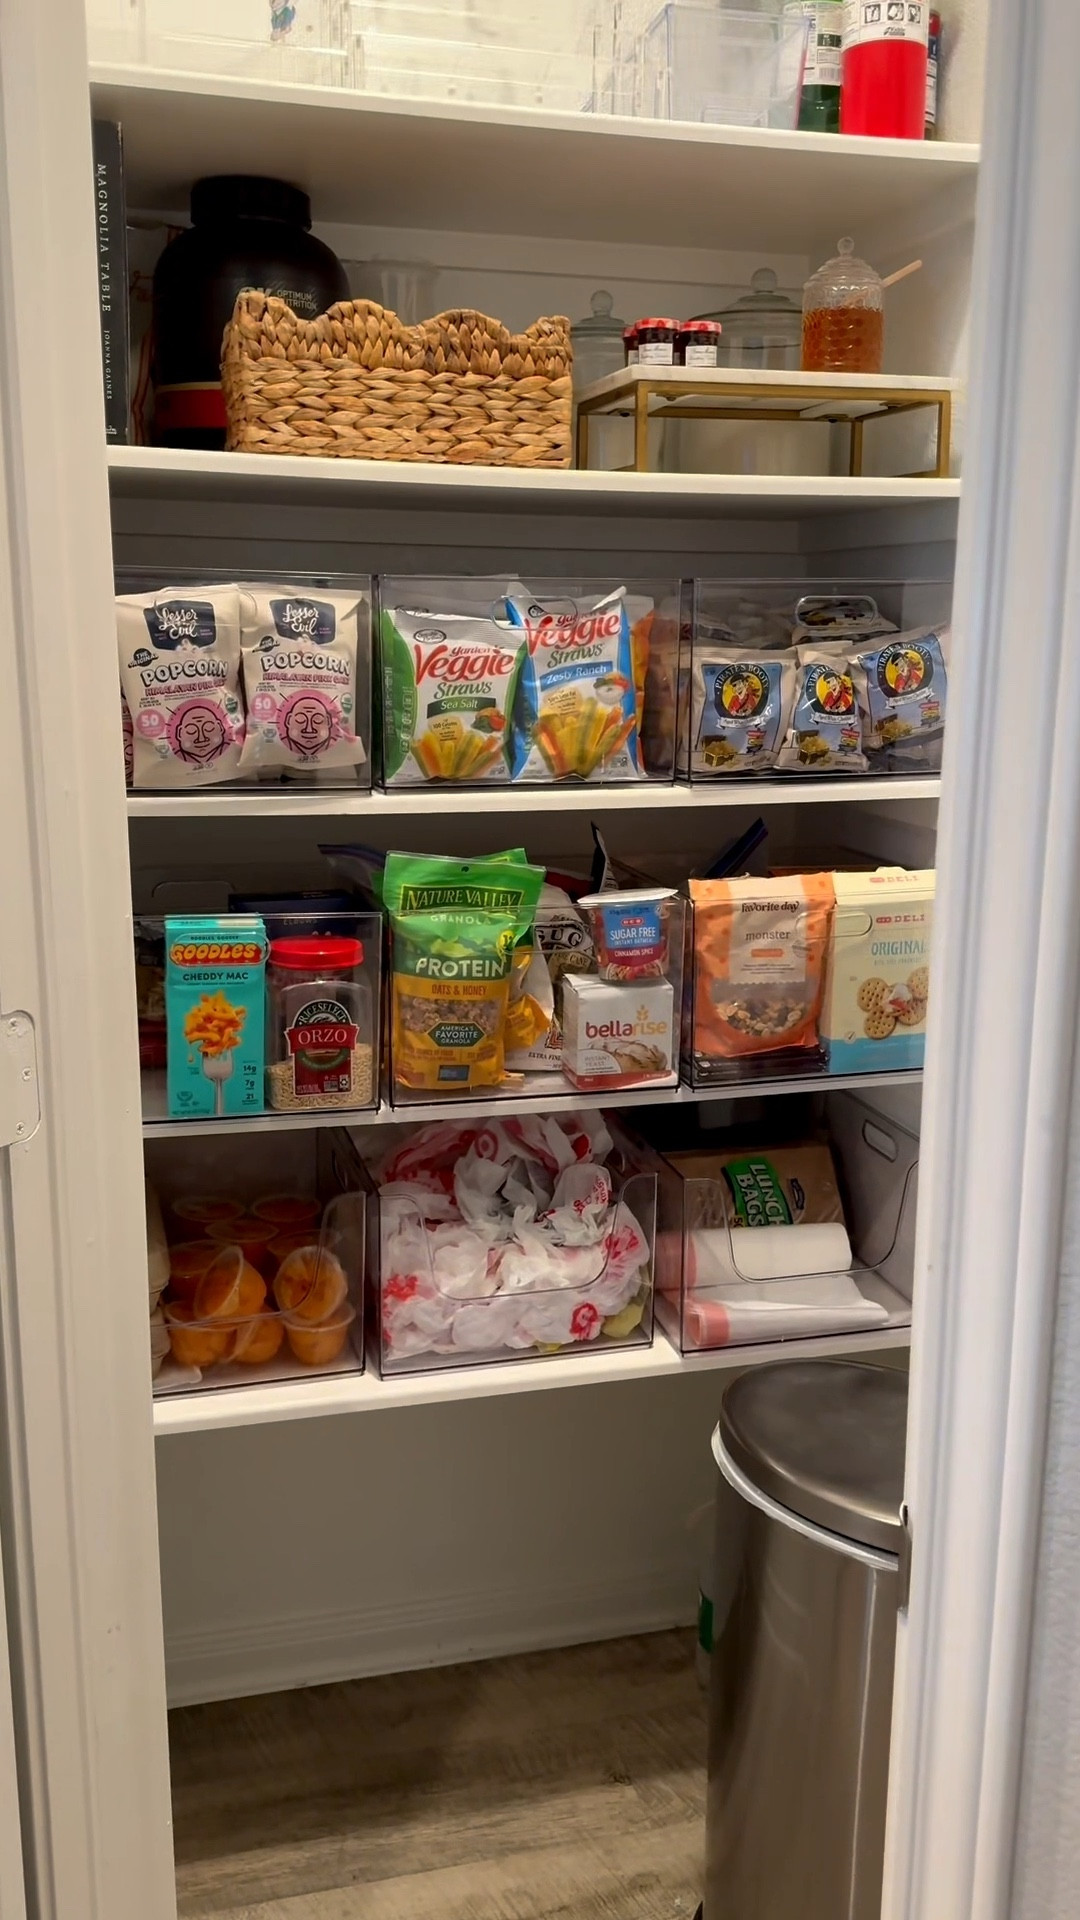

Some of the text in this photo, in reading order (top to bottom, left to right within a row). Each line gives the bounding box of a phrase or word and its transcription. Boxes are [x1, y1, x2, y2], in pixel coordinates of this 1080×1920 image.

[98, 163, 111, 312] MAGNOLIA TABLE
[276, 289, 312, 301] OPTIMUM
[525, 612, 621, 656] Veggie
[547, 643, 604, 668] Straws
[261, 652, 351, 676] POPCORN
[414, 644, 514, 685] Veggie
[141, 660, 228, 687] POPCORN
[546, 665, 607, 685] Zesty Ranch
[434, 682, 492, 699] Straws
[255, 698, 271, 710] 50
[440, 699, 478, 710] Sea Salt
[141, 714, 159, 727] 50
[407, 890, 516, 911] NATURE VALLEY
[742, 901, 799, 913] favorite day
[430, 915, 491, 925] GRANOLA
[895, 914, 925, 923] DELI
[610, 927, 656, 940] SUGAR FREE
[746, 931, 791, 941] monster
[172, 943, 258, 962] GOODLES
[416, 958, 504, 977] PROTEIN
[183, 972, 249, 981] CHEDDY MAC
[432, 983, 451, 995] OATS
[463, 985, 487, 995] HONEY
[299, 1002, 346, 1022] RICESELECT
[298, 1029, 347, 1045] ORZO
[435, 1031, 479, 1039] FAVORITE
[585, 1020, 668, 1038] bellarise
[243, 1065, 257, 1073] 14g
[245, 1079, 255, 1087] 7g
[735, 1174, 765, 1227] BAGS
